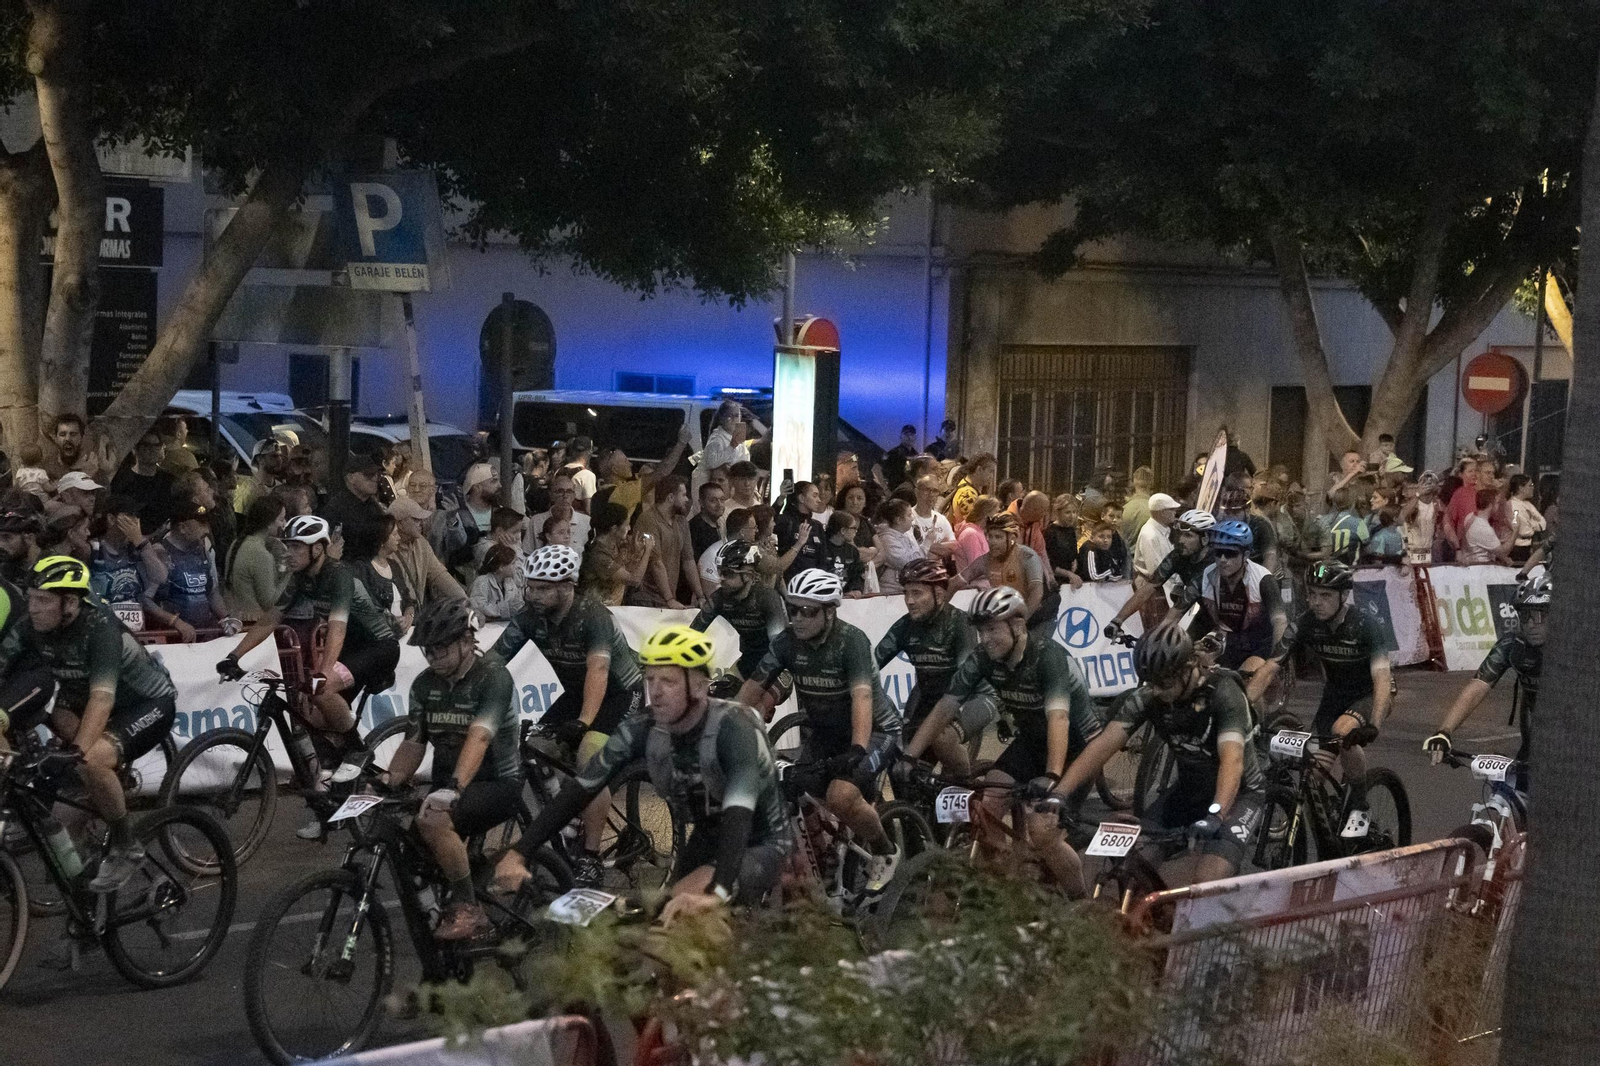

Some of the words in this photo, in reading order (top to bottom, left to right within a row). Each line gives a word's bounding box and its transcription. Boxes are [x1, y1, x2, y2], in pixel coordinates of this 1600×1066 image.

[350, 183, 402, 256] P
[354, 266, 391, 277] GARAJE
[395, 266, 425, 278] BELÉN
[119, 612, 140, 622] 3433
[125, 708, 164, 737] LANDBIKE
[942, 795, 967, 810] 5745
[1100, 834, 1134, 848] 6800
